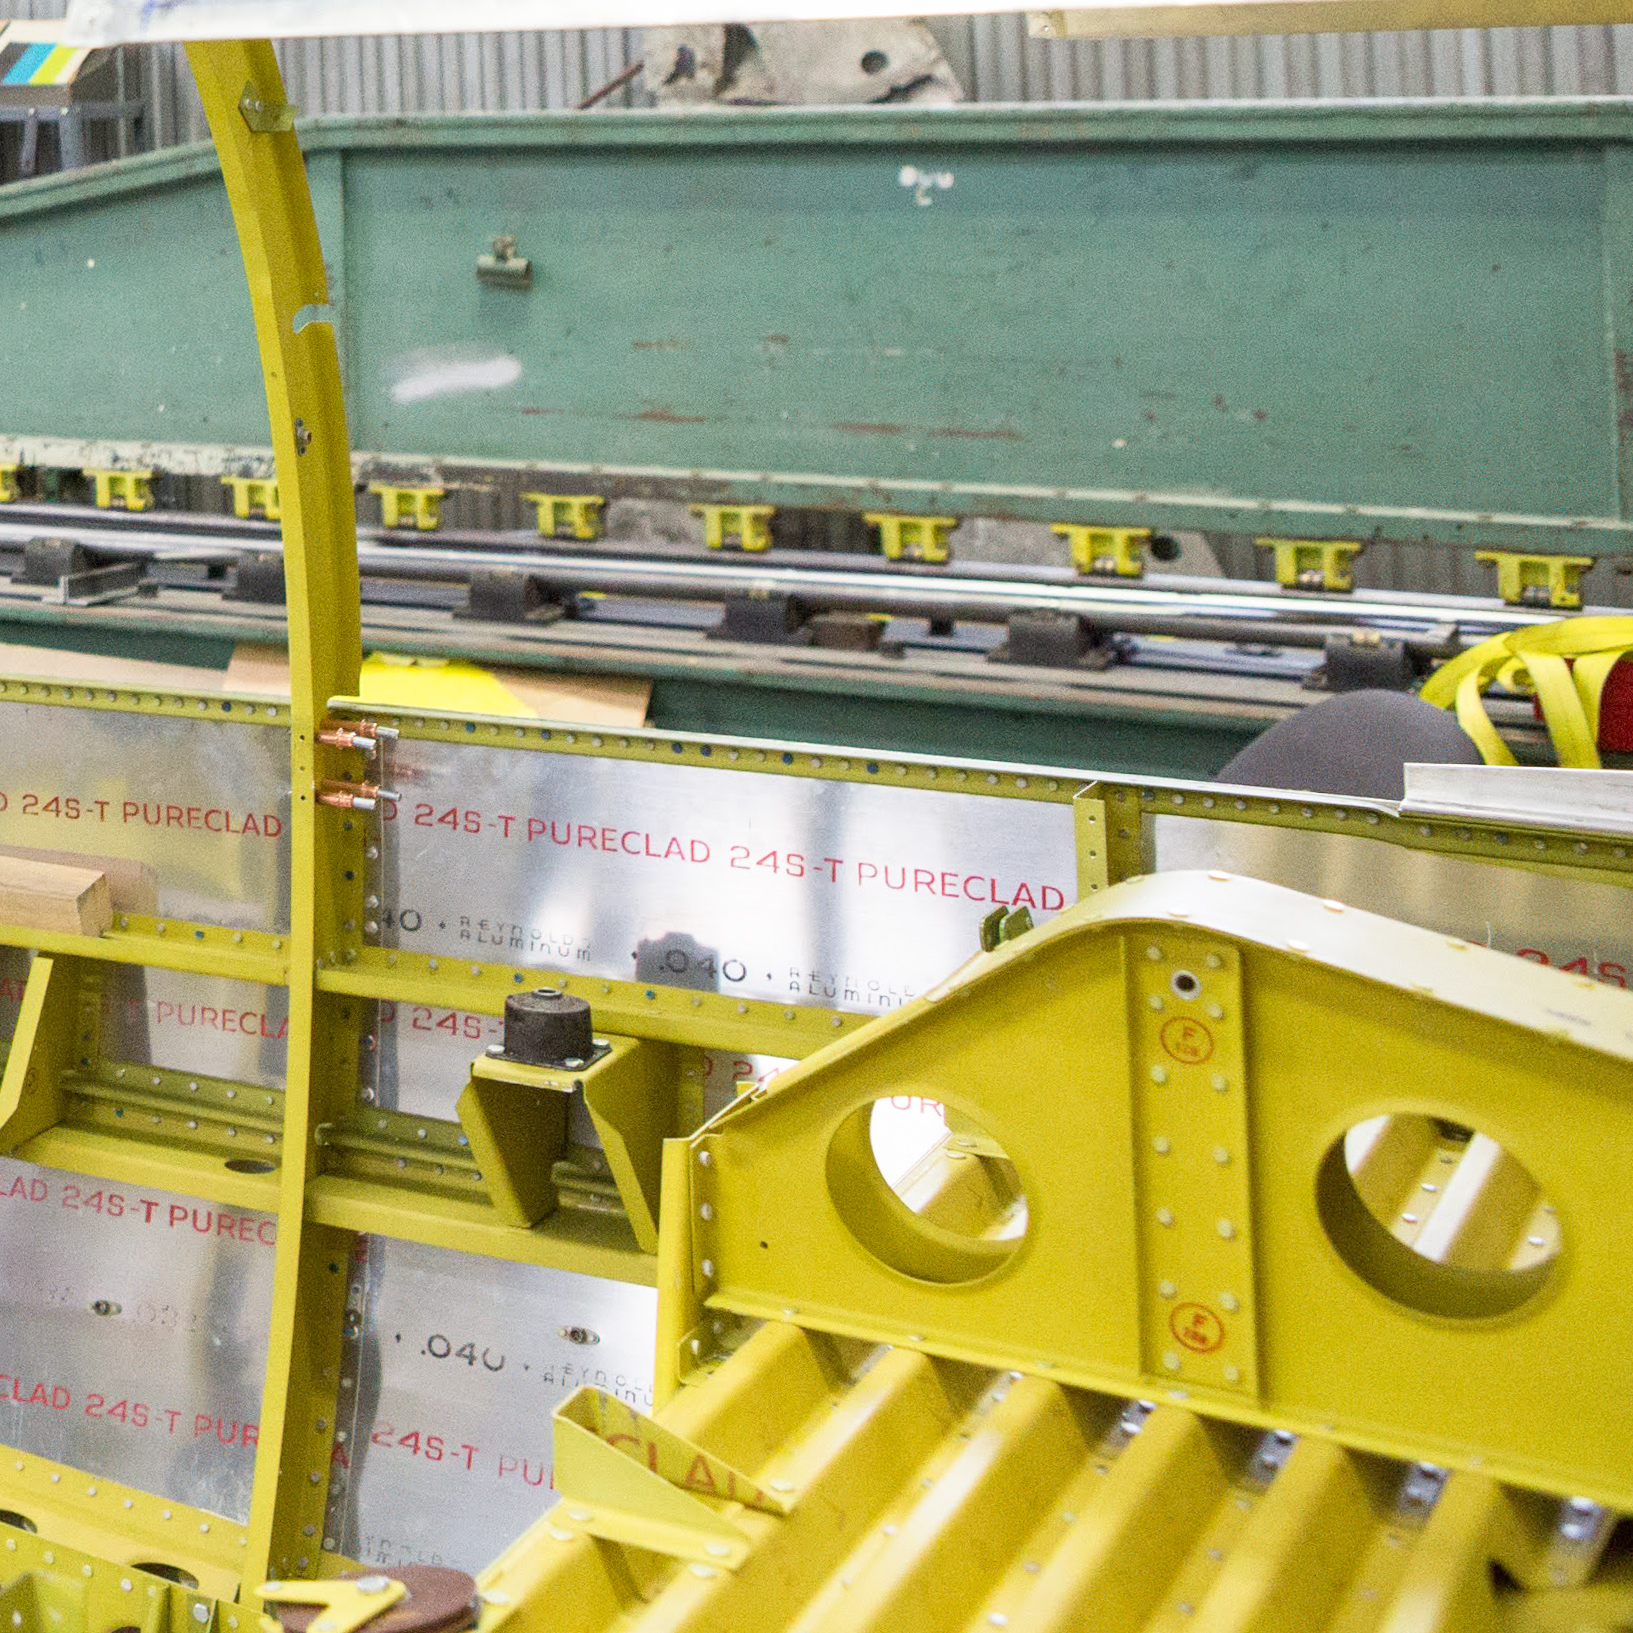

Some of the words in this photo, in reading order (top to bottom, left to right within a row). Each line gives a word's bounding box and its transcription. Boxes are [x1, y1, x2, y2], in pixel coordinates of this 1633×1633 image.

[21, 793, 111, 824] 24S-T
[123, 800, 284, 840] PURECLAD
[414, 803, 515, 843] 24S-T
[527, 818, 711, 866] PURECLAD
[729, 844, 844, 884] 24S-T
[856, 862, 1066, 914] PURECLAD
[62, 1184, 159, 1225] 24S-T
[84, 1392, 183, 1436] 24S-T
[372, 1426, 480, 1471] 24S-T
